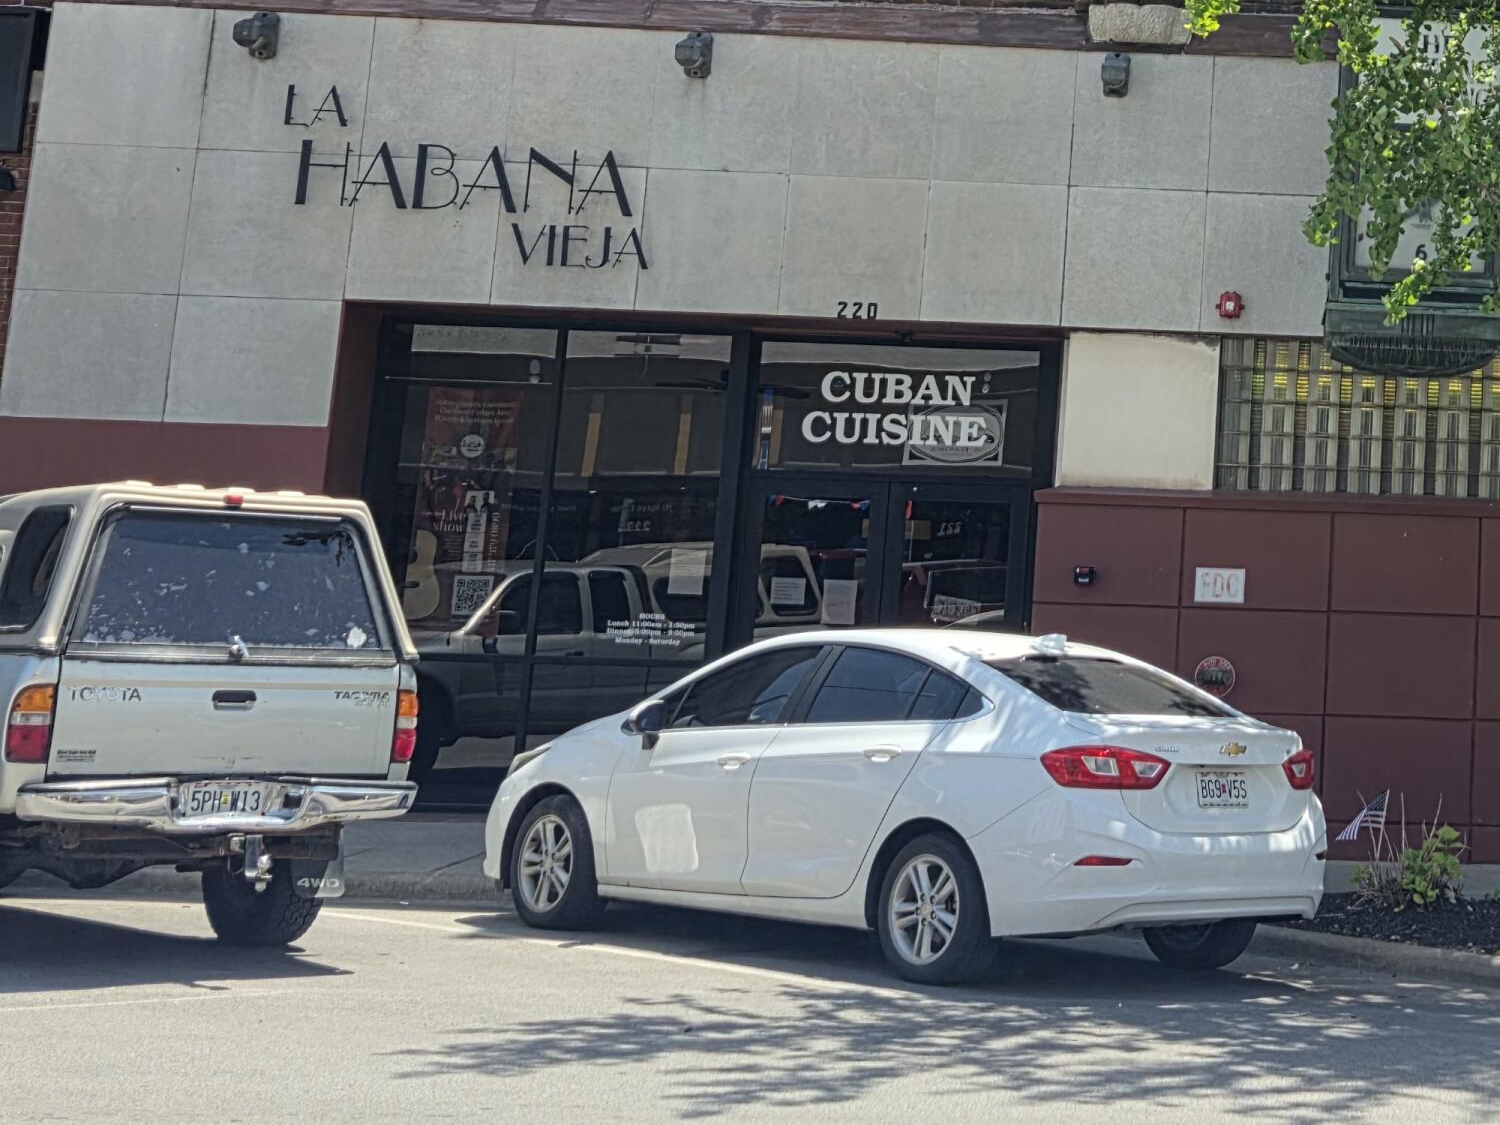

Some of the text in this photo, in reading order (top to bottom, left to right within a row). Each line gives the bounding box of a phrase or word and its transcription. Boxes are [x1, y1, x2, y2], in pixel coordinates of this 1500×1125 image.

[284, 84, 348, 126] LA
[294, 139, 633, 217] HABANA
[511, 222, 649, 270] VIEJA
[836, 301, 879, 320] 220
[820, 371, 976, 406] CUBAN
[801, 410, 988, 447] CUISINE
[68, 687, 142, 701] TOYOTA
[191, 790, 260, 812] 5PH W13
[1200, 779, 1247, 799] BG9 V5S
[297, 877, 340, 888] 4WD
